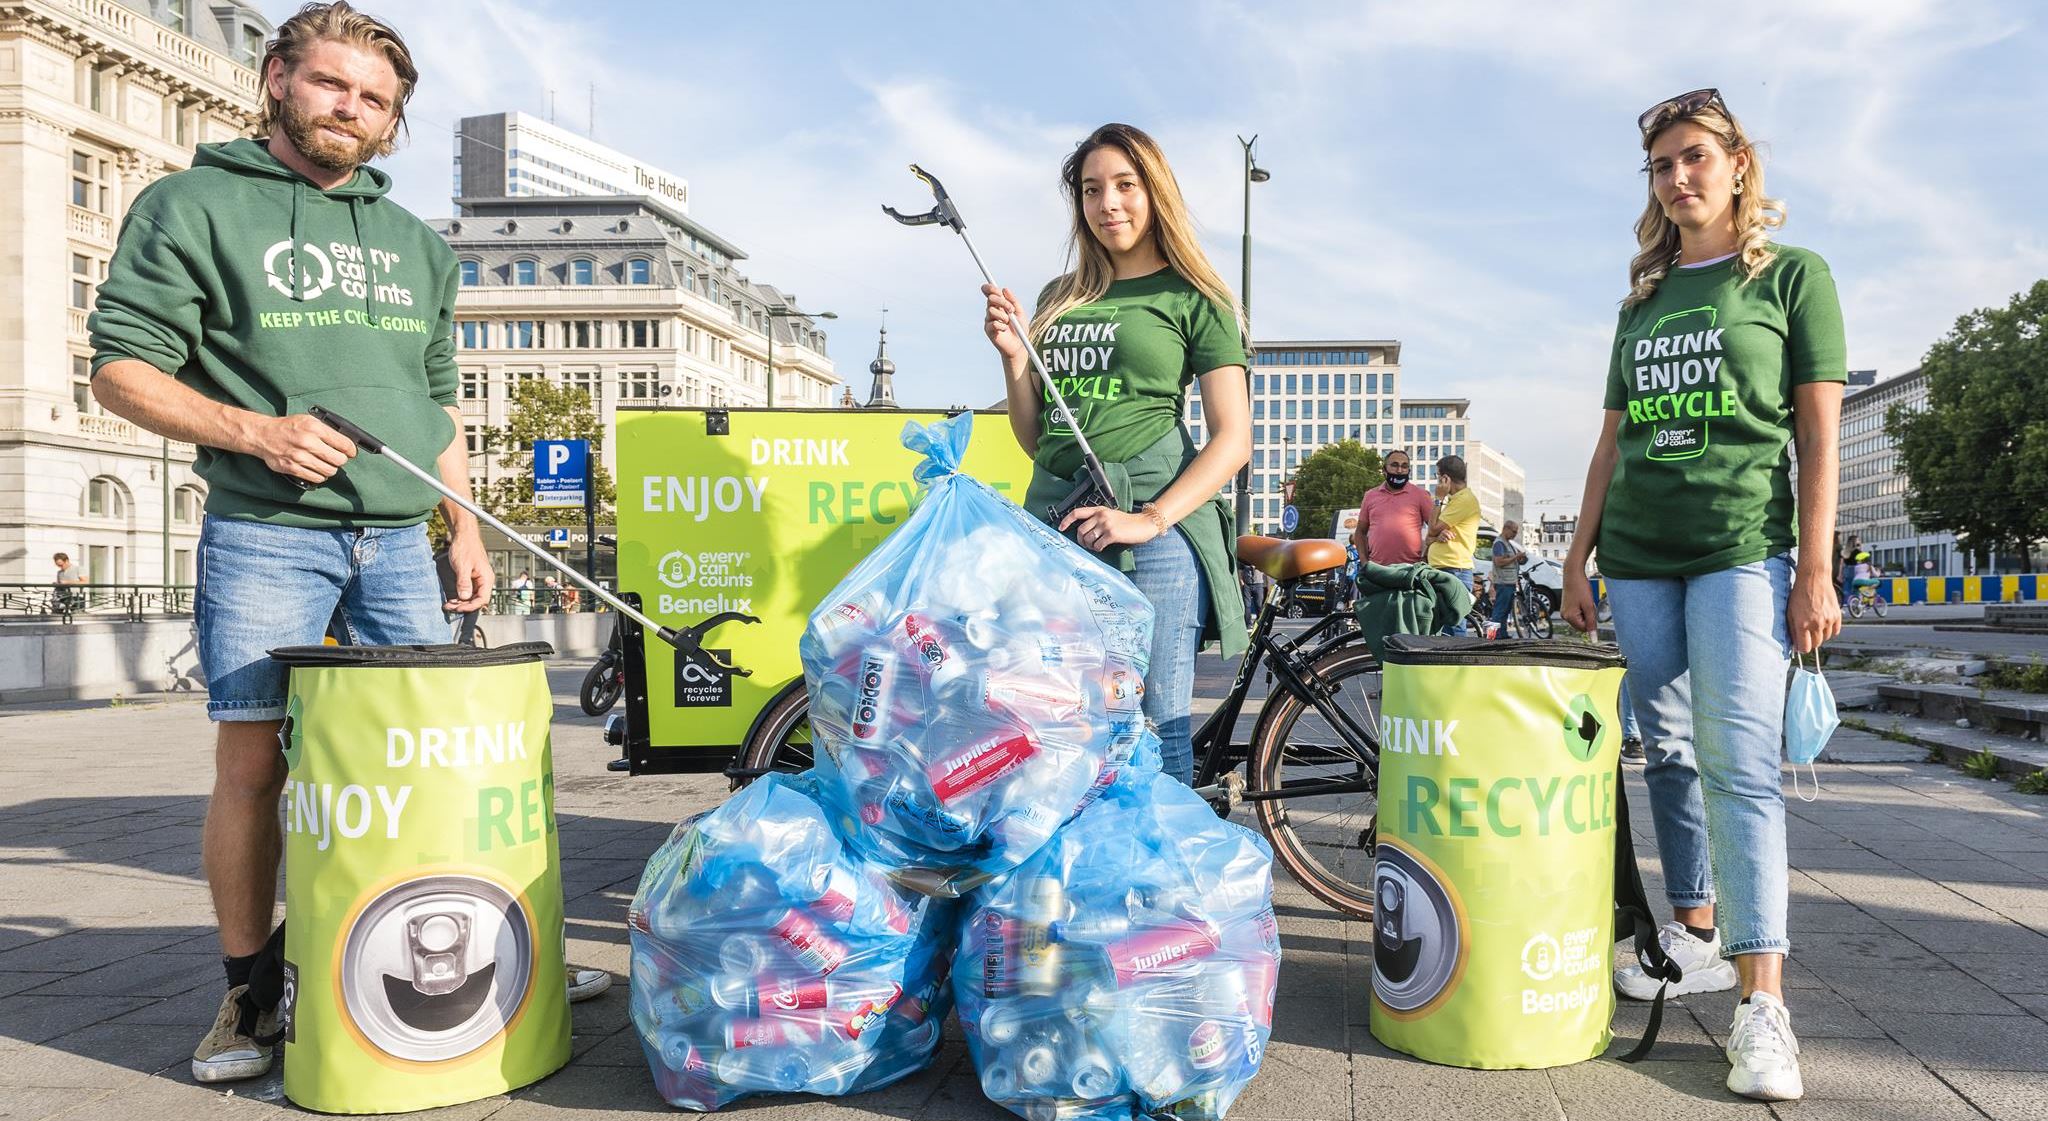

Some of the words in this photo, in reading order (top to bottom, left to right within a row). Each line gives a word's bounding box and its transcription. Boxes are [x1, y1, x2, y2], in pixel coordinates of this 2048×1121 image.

[633, 165, 655, 190] The
[658, 175, 687, 203] Hotel
[259, 311, 302, 328] KEEP
[304, 309, 342, 327] THE
[380, 315, 427, 335] GOING
[1043, 322, 1121, 344] DRINK
[1634, 327, 1725, 361] DRINK
[1042, 346, 1115, 377] ENJOY
[1635, 356, 1723, 394] ENJOY
[1628, 390, 1737, 425] RECYCLE
[751, 438, 850, 466] DRINK
[1669, 438, 1697, 447] counts
[548, 444, 570, 475] P
[643, 475, 769, 523] ENJOY
[554, 529, 564, 541] P
[698, 564, 729, 576] can
[698, 574, 753, 588] counts
[658, 593, 753, 614] Benelux
[683, 686, 723, 696] recycles
[386, 721, 528, 768] DRINK
[942, 735, 999, 778] Jupiler
[1407, 771, 1613, 838] RECYCLE
[1130, 942, 1191, 976] Jupiler
